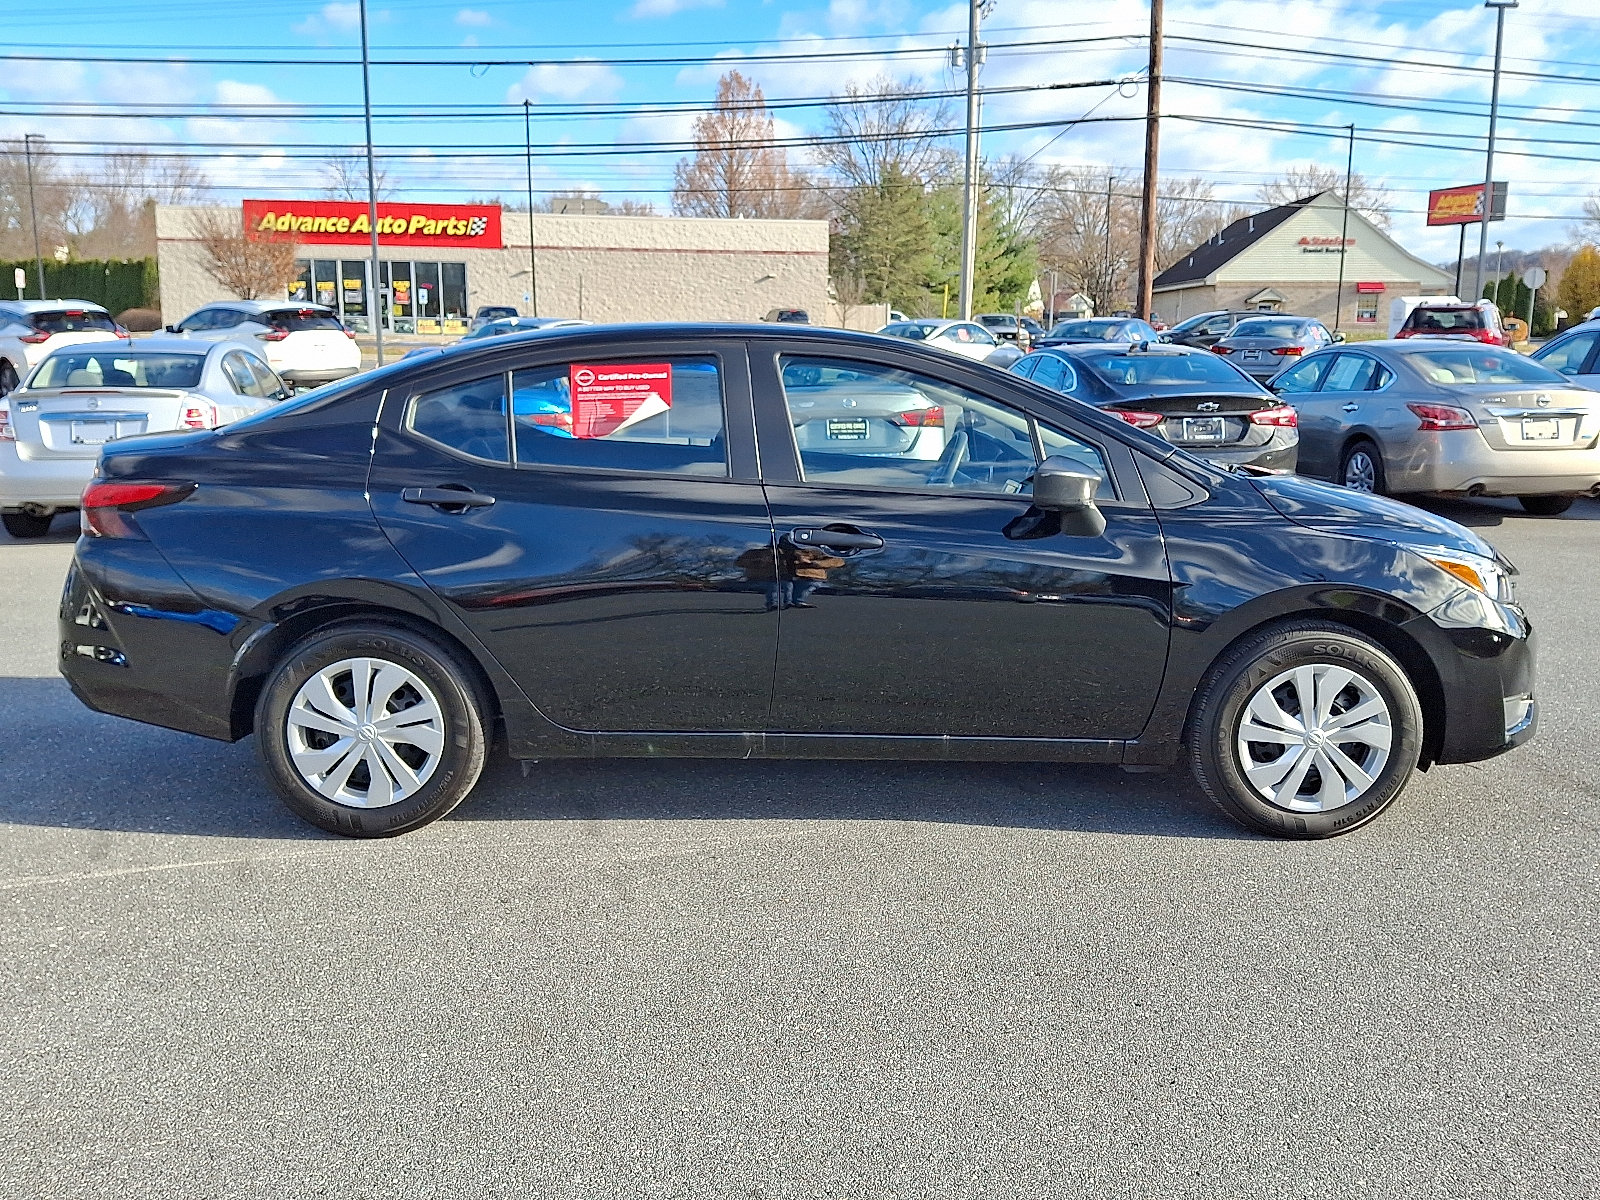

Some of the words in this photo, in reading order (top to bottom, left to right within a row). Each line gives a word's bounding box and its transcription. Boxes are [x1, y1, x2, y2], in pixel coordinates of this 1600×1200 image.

[258, 211, 350, 233] Advance
[350, 213, 408, 235] Auto
[408, 215, 468, 236] Parts
[598, 373, 628, 381] Certified
[1312, 643, 1381, 672] SOLUS
